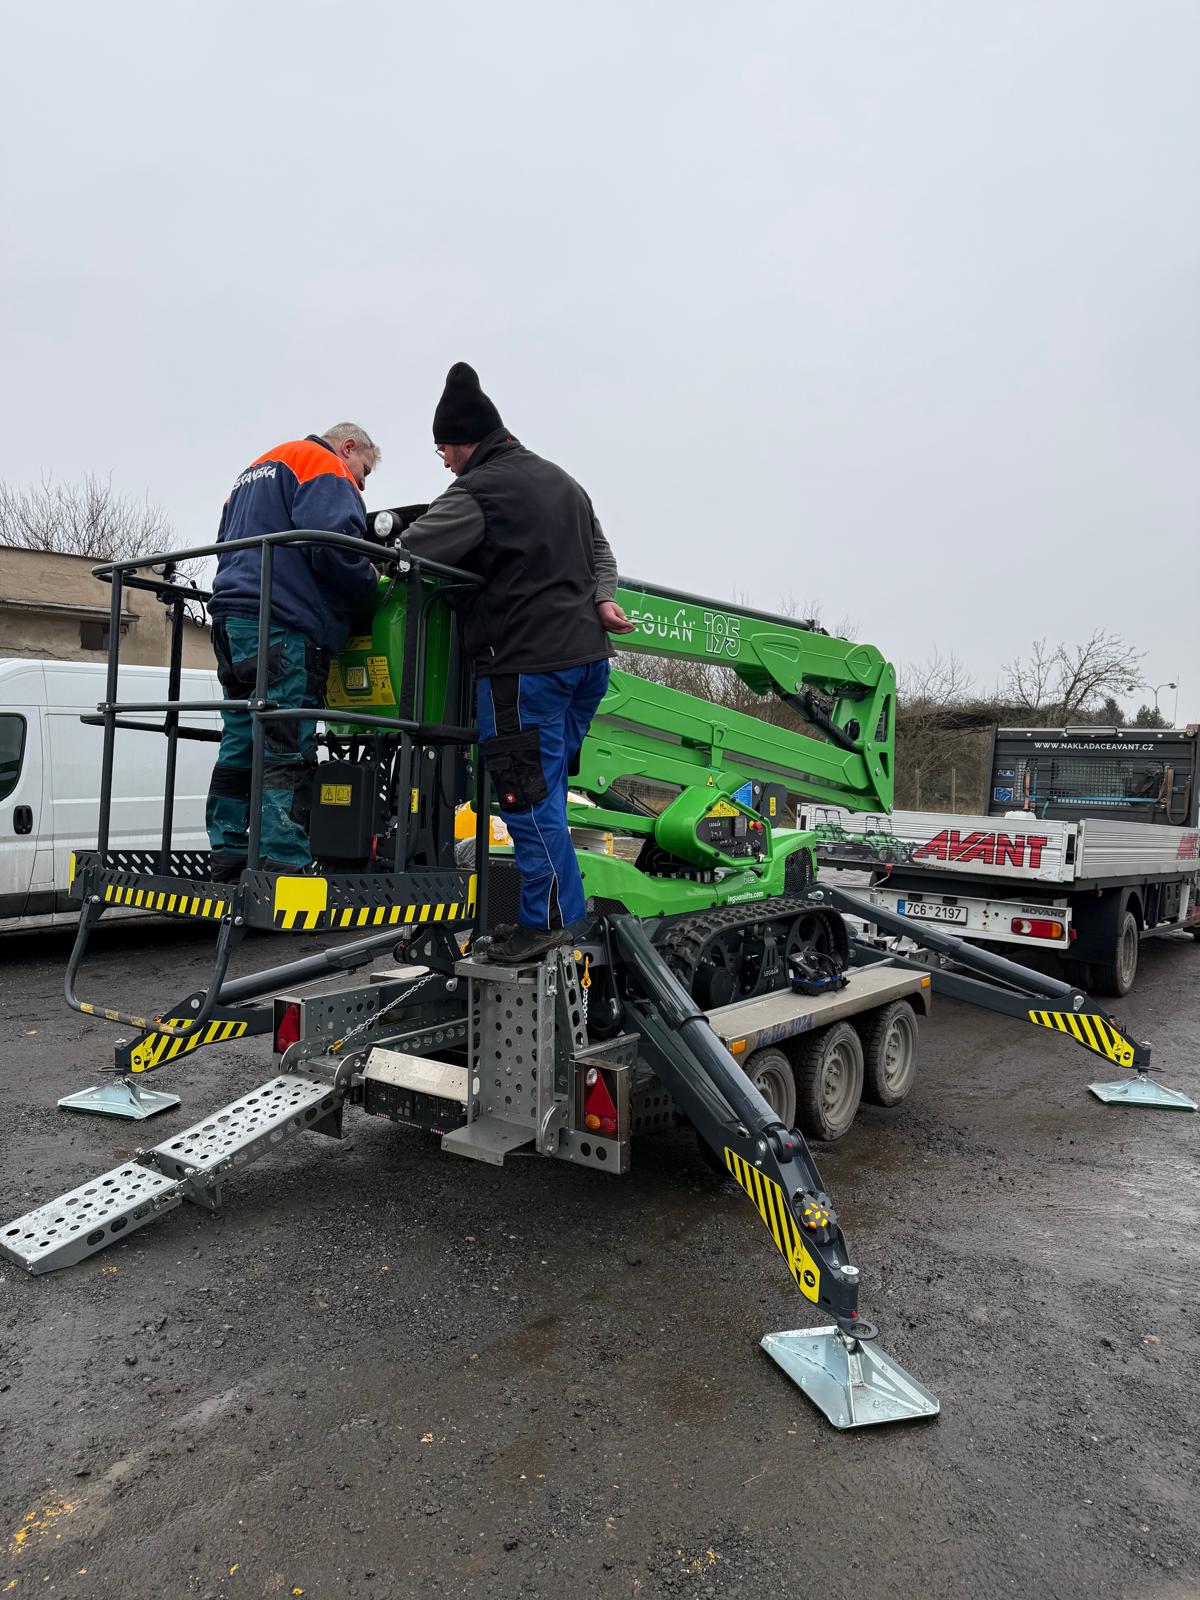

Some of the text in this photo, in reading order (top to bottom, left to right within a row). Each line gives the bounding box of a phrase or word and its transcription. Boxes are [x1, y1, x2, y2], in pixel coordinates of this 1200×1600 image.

[233, 465, 277, 489] SKANSKA
[629, 609, 741, 657] EGUAN 195
[1034, 741, 1155, 751] WWW.NAKLADACEAVANT.CZ
[912, 829, 1048, 869] AVANT
[727, 891, 764, 904] leguanlifts.com
[907, 902, 962, 920] 7C6 2197
[1021, 907, 1066, 918] MOVANO
